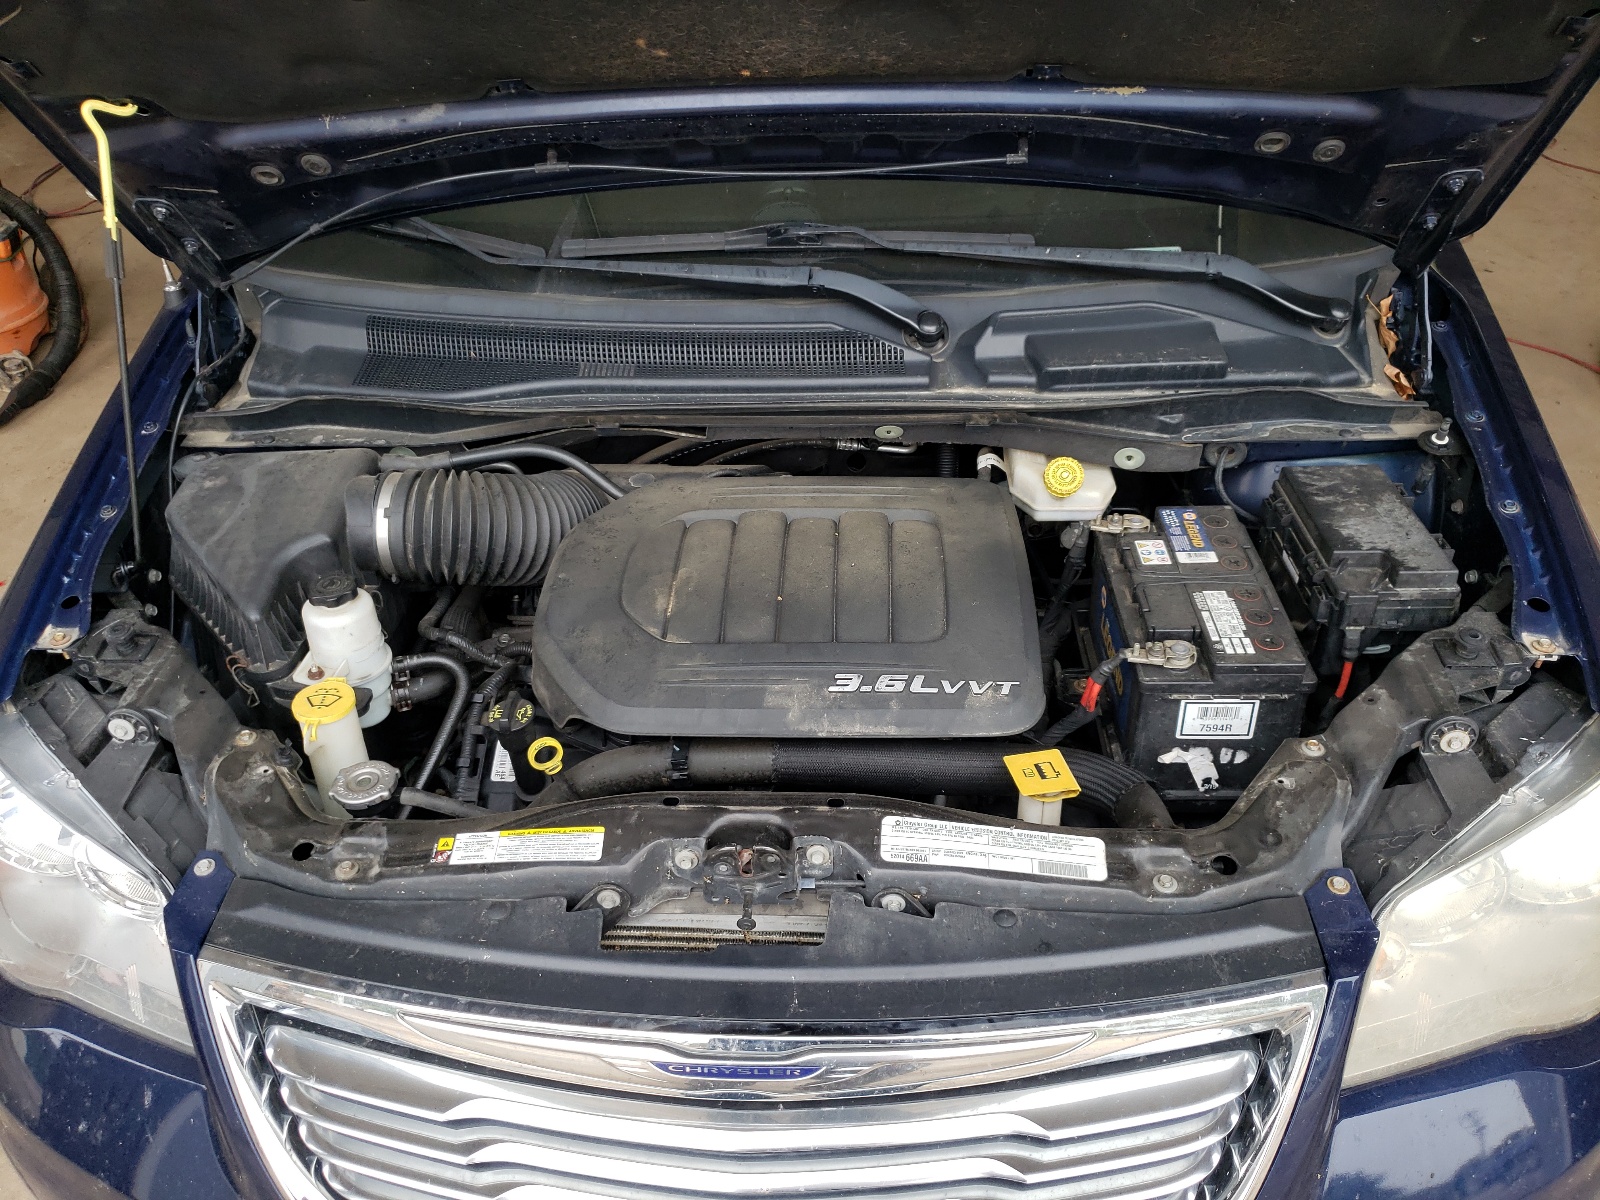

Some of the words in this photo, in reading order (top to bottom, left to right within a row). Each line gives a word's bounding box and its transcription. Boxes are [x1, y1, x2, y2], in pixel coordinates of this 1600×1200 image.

[1183, 520, 1205, 548] LEGEND
[1199, 723, 1232, 732] 7594R
[668, 1065, 801, 1076] CHRYSLER
